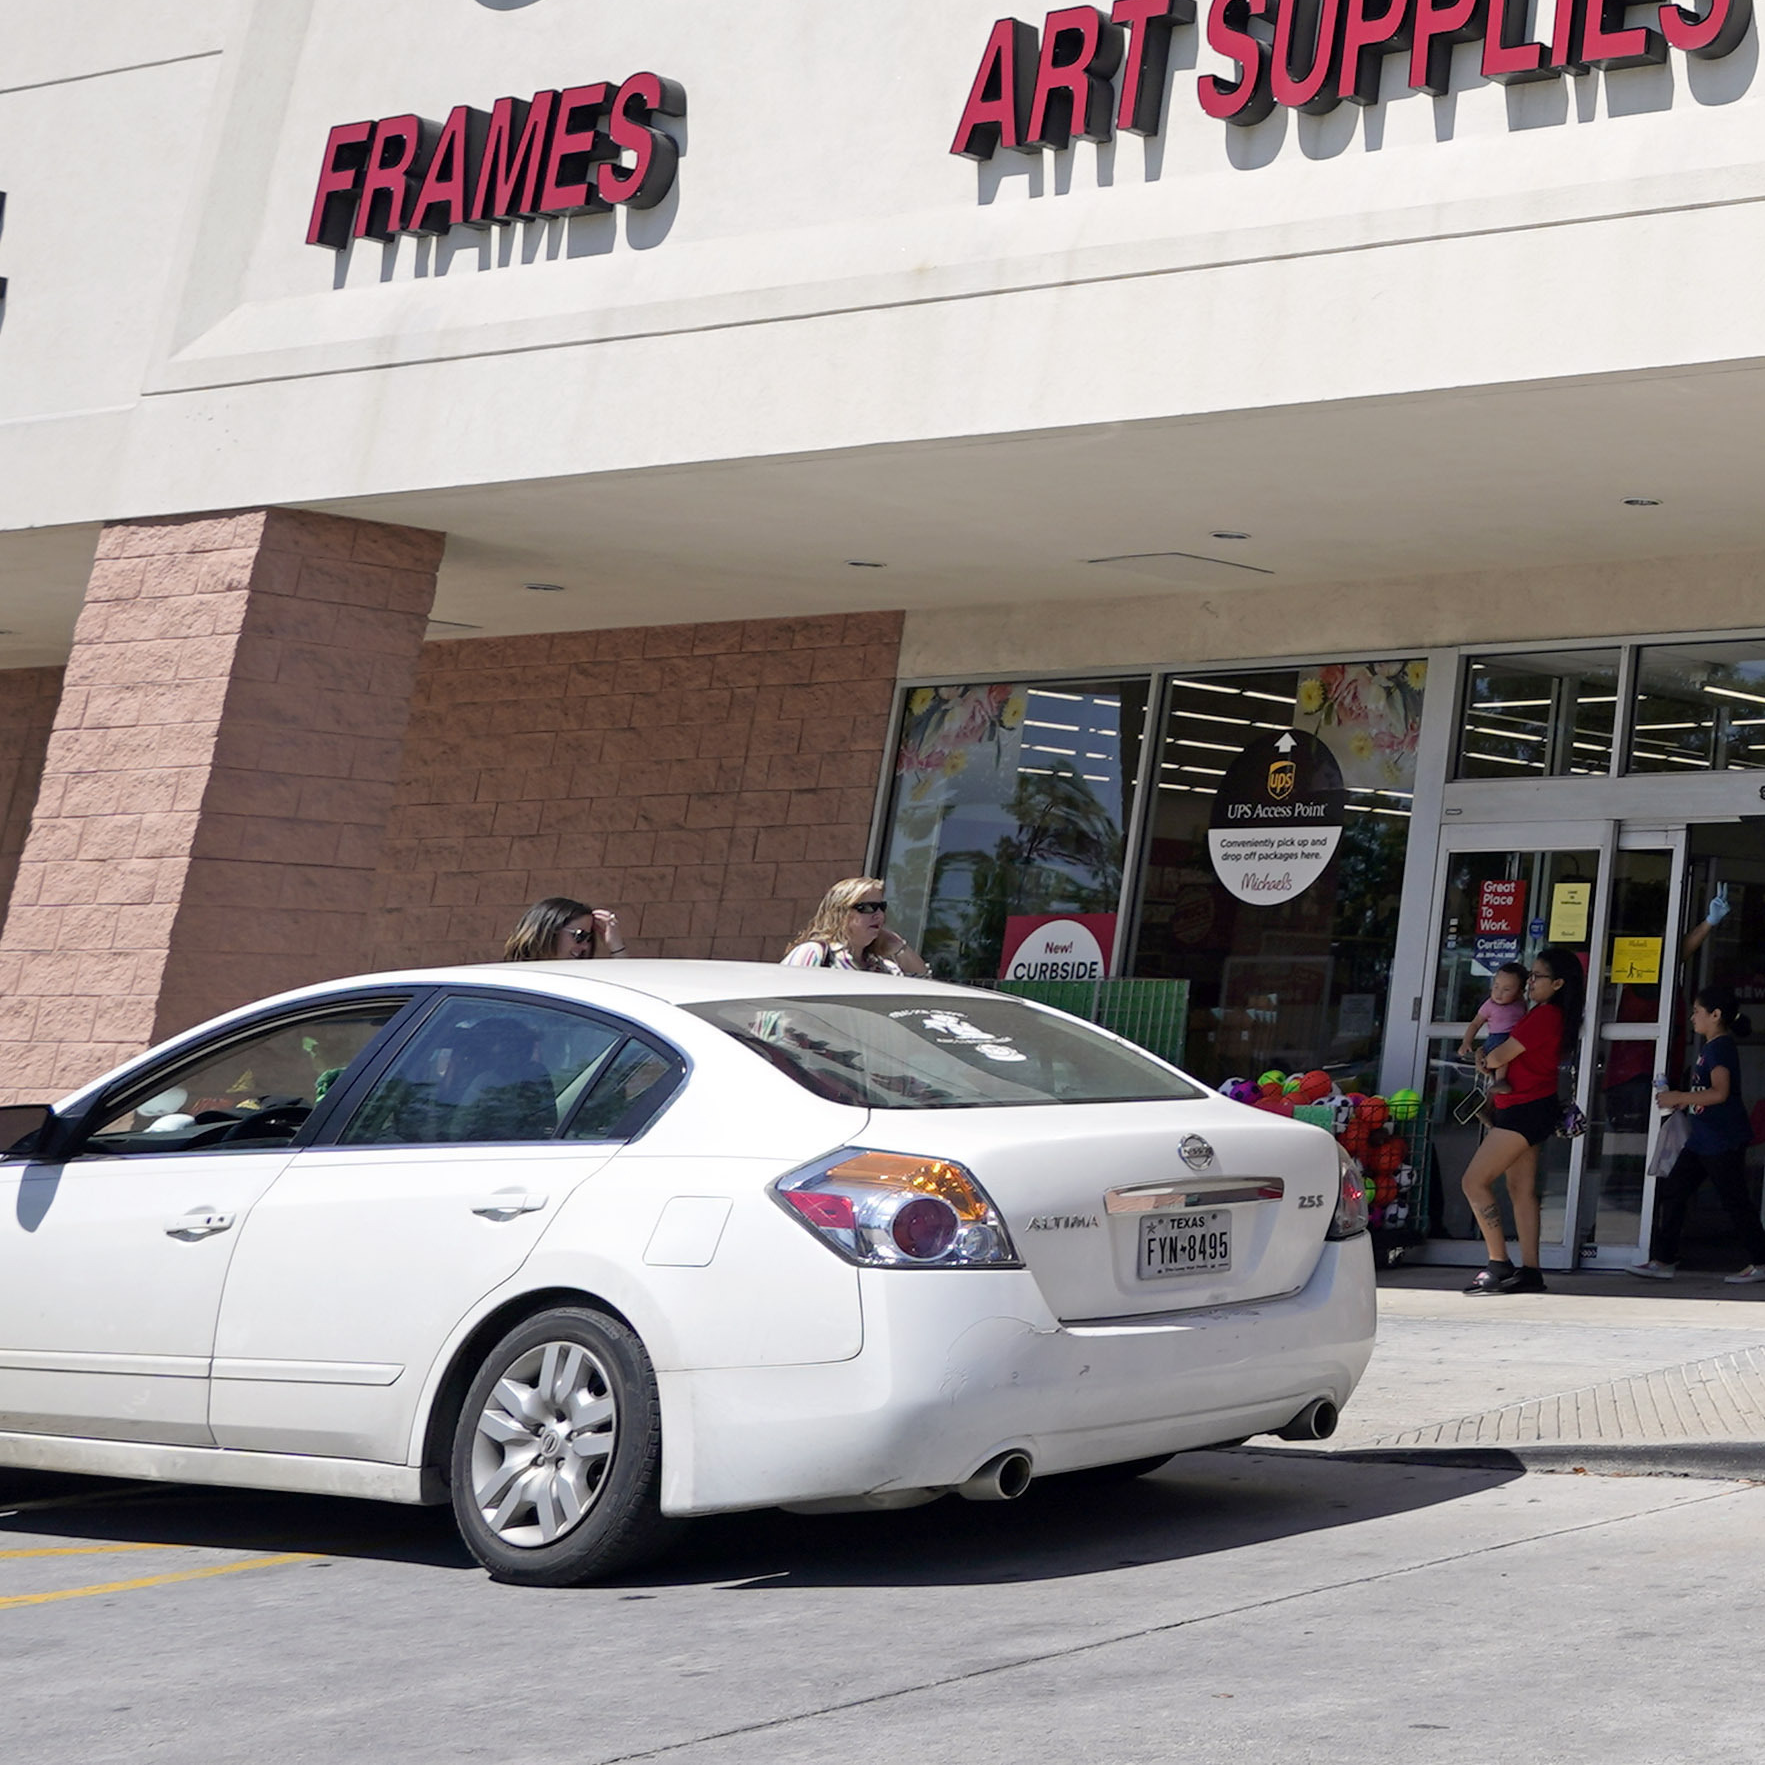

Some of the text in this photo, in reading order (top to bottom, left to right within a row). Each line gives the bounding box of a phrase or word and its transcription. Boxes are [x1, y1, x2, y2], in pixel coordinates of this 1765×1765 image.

[304, 71, 680, 249] FRAMES
[1270, 772, 1294, 794] ups
[1228, 804, 1251, 819] UPS
[1253, 803, 1292, 818] Access
[1220, 837, 1327, 849] Conveniently pick up and
[1221, 850, 1322, 863] drop off packages here.
[1241, 872, 1293, 891] Michaels
[1483, 880, 1516, 893] Great
[1482, 894, 1514, 905] Place
[1481, 906, 1494, 918] To
[1044, 940, 1074, 954] New!
[1477, 938, 1517, 950] Certified
[1014, 961, 1099, 981] CURBSIDE
[1025, 1214, 1099, 1233] ALTIMA
[1170, 1216, 1205, 1230] TEXAS
